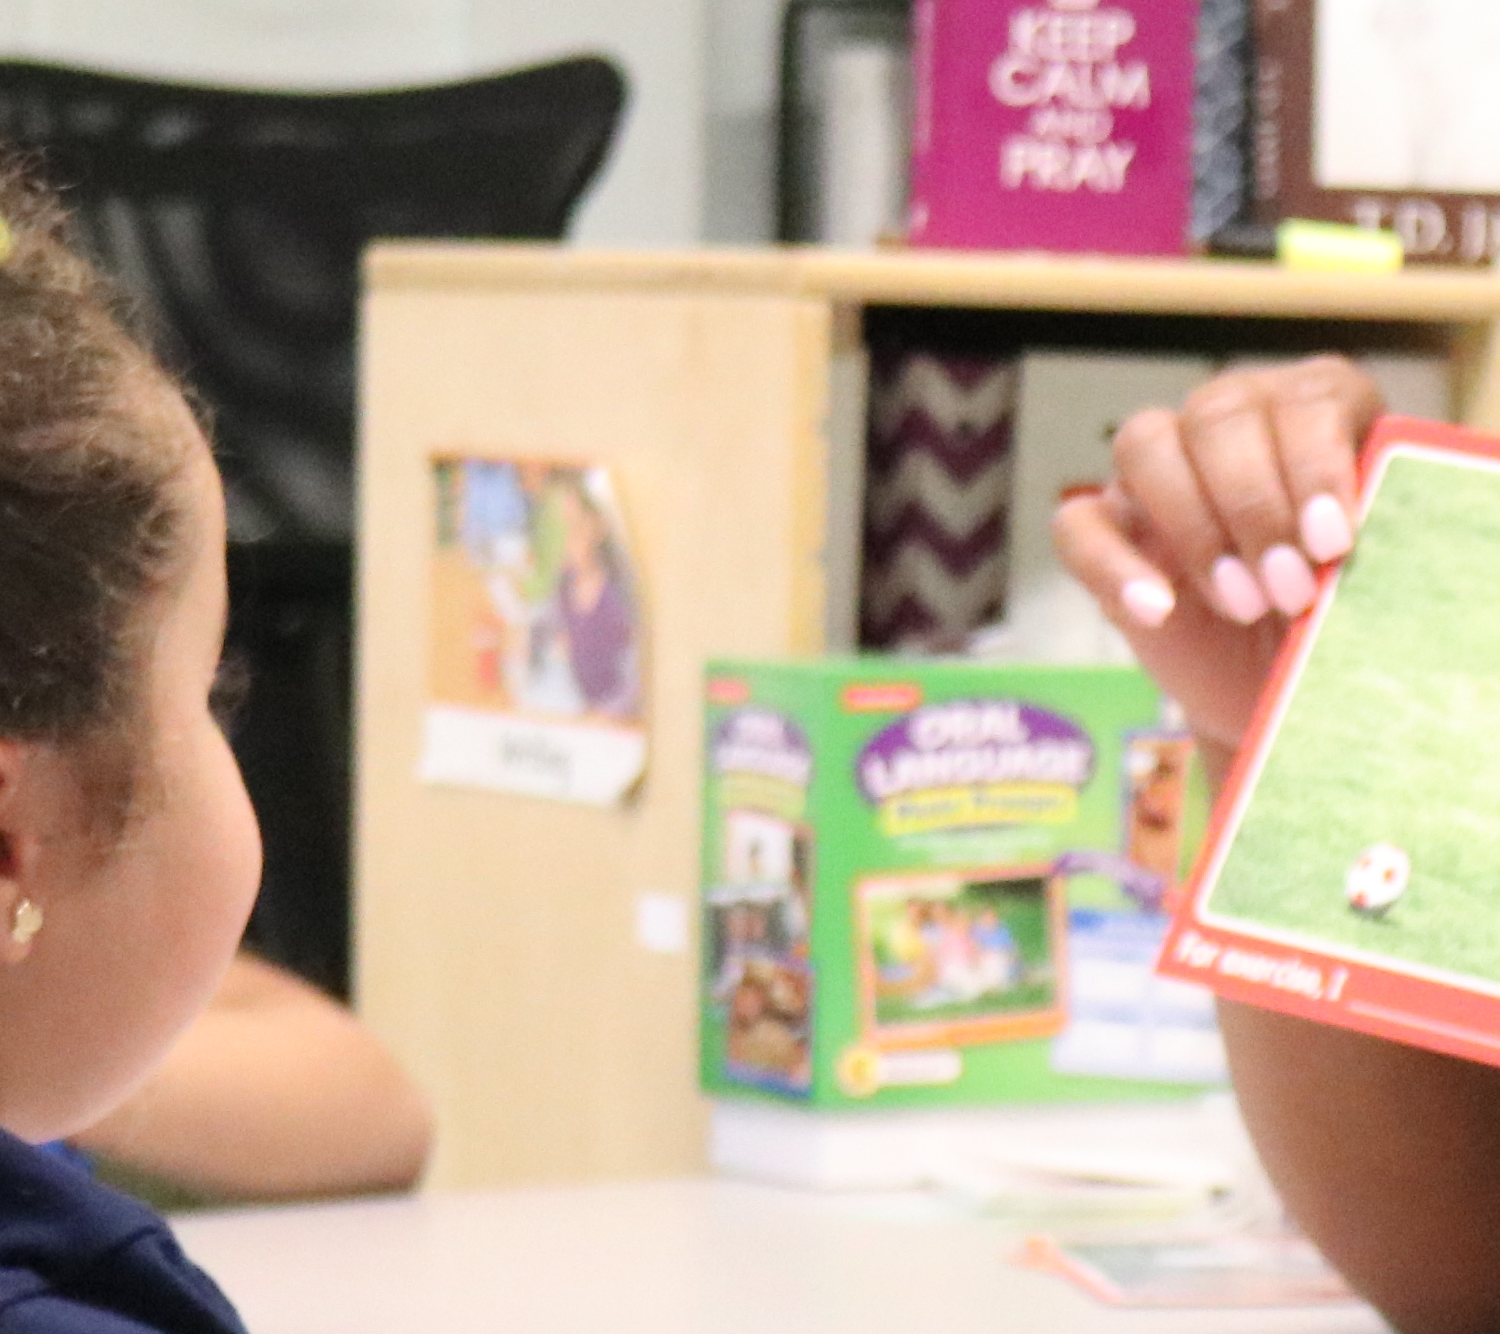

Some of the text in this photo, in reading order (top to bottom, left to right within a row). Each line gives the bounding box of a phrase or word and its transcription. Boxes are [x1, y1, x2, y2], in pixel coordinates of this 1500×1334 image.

[1008, 9, 1137, 60] KEEP
[988, 60, 1151, 109] CALM
[1033, 107, 1114, 144] AND
[1001, 142, 1137, 193] PRAY
[912, 703, 1029, 752] ORAL
[864, 743, 1092, 797] LANGUAGE
[1174, 930, 1219, 969] For
